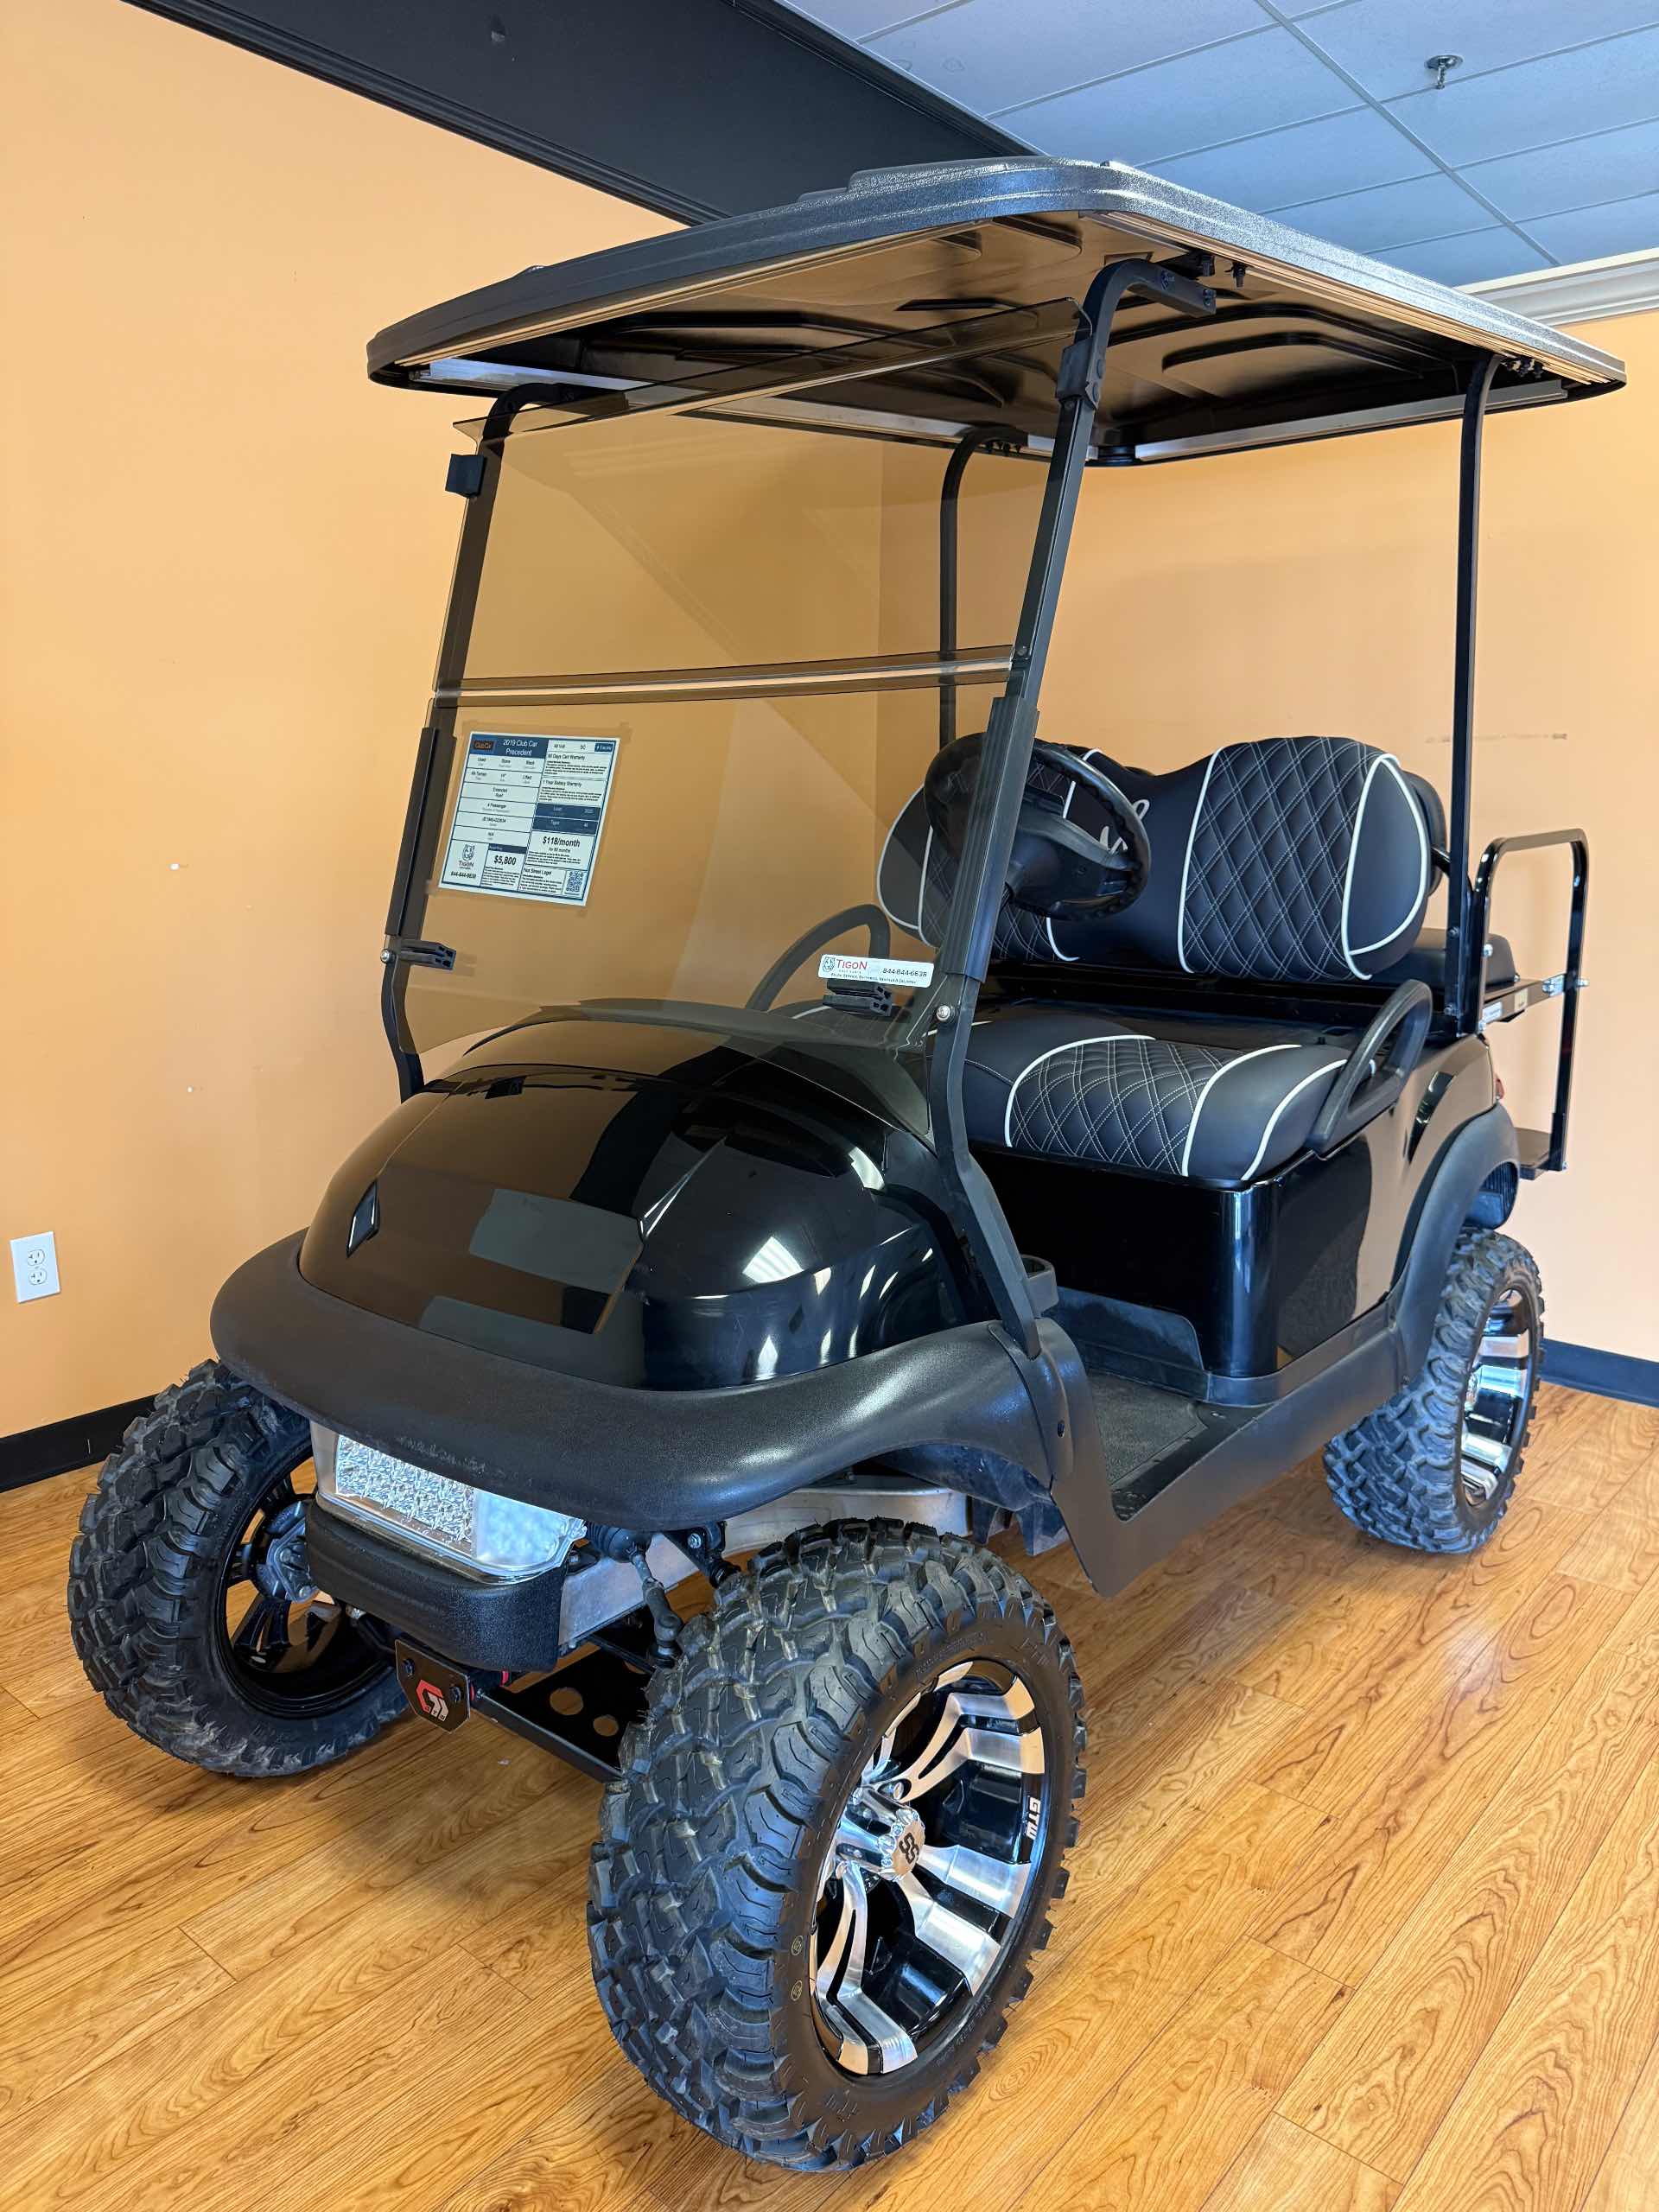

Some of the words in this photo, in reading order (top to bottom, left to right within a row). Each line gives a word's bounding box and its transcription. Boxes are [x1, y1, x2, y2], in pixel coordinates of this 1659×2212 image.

[543, 836, 580, 848] $118/month
[493, 855, 517, 865] $5,800
[1027, 1796, 1041, 1840] GTW
